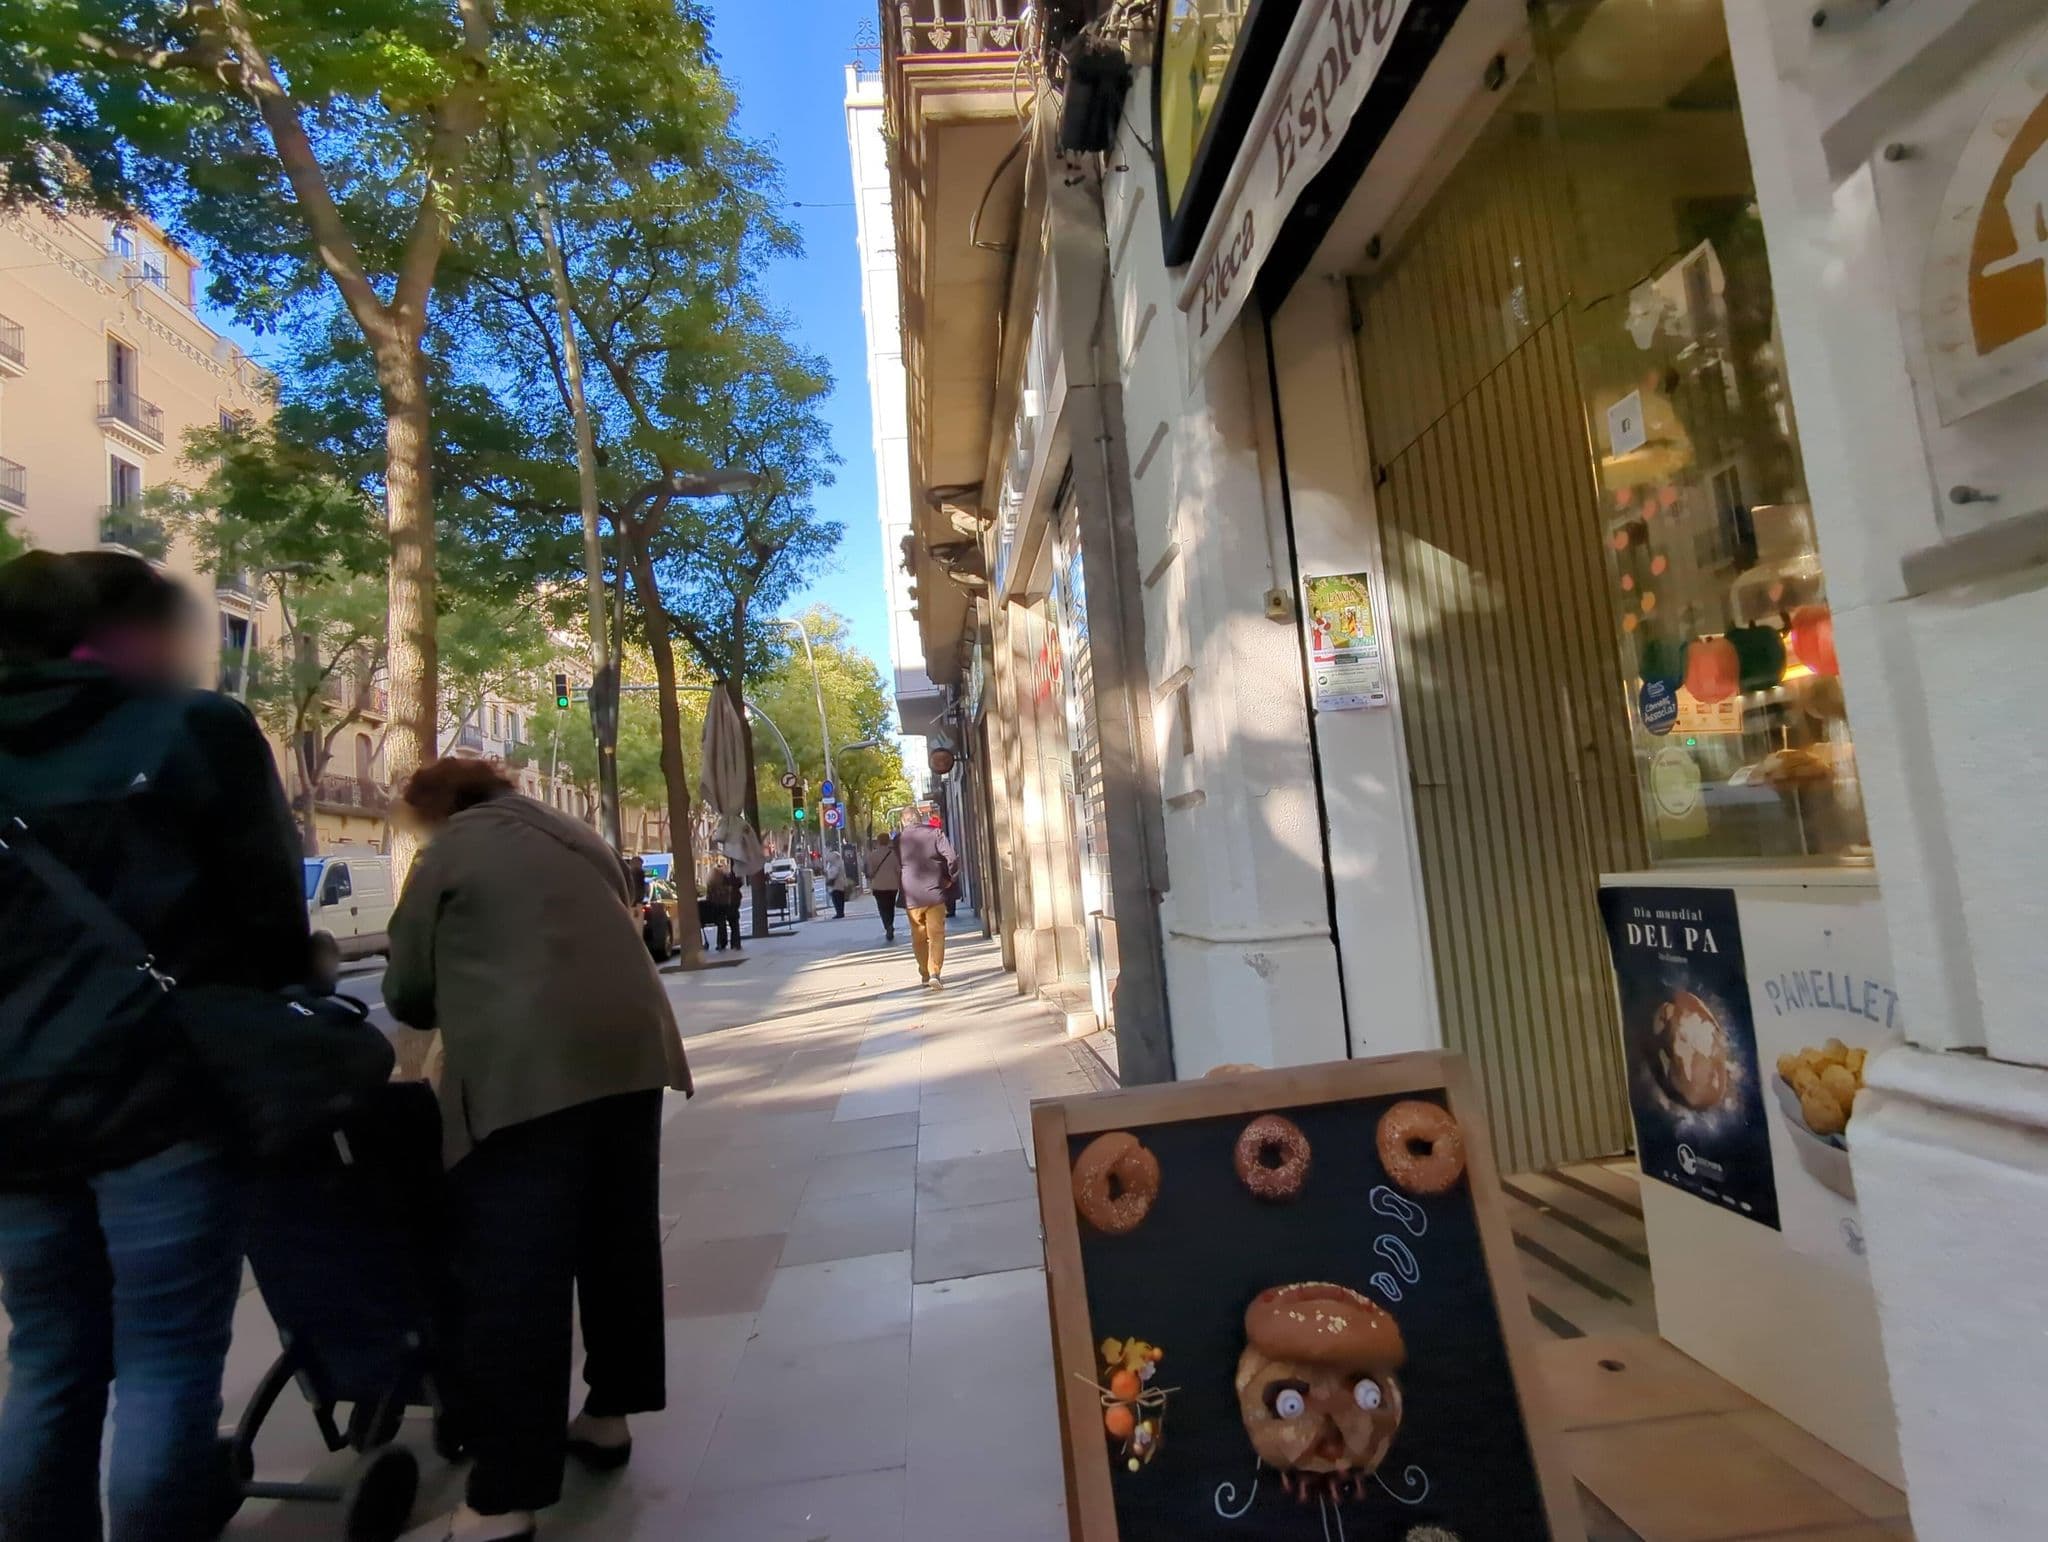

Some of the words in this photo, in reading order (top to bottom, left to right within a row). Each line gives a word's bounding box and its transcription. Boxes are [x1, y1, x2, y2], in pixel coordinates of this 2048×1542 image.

[1201, 208, 1255, 336] Fleca
[1656, 908, 1703, 921] mundial
[1627, 923, 1673, 949] DEL
[1684, 927, 1719, 953] PA
